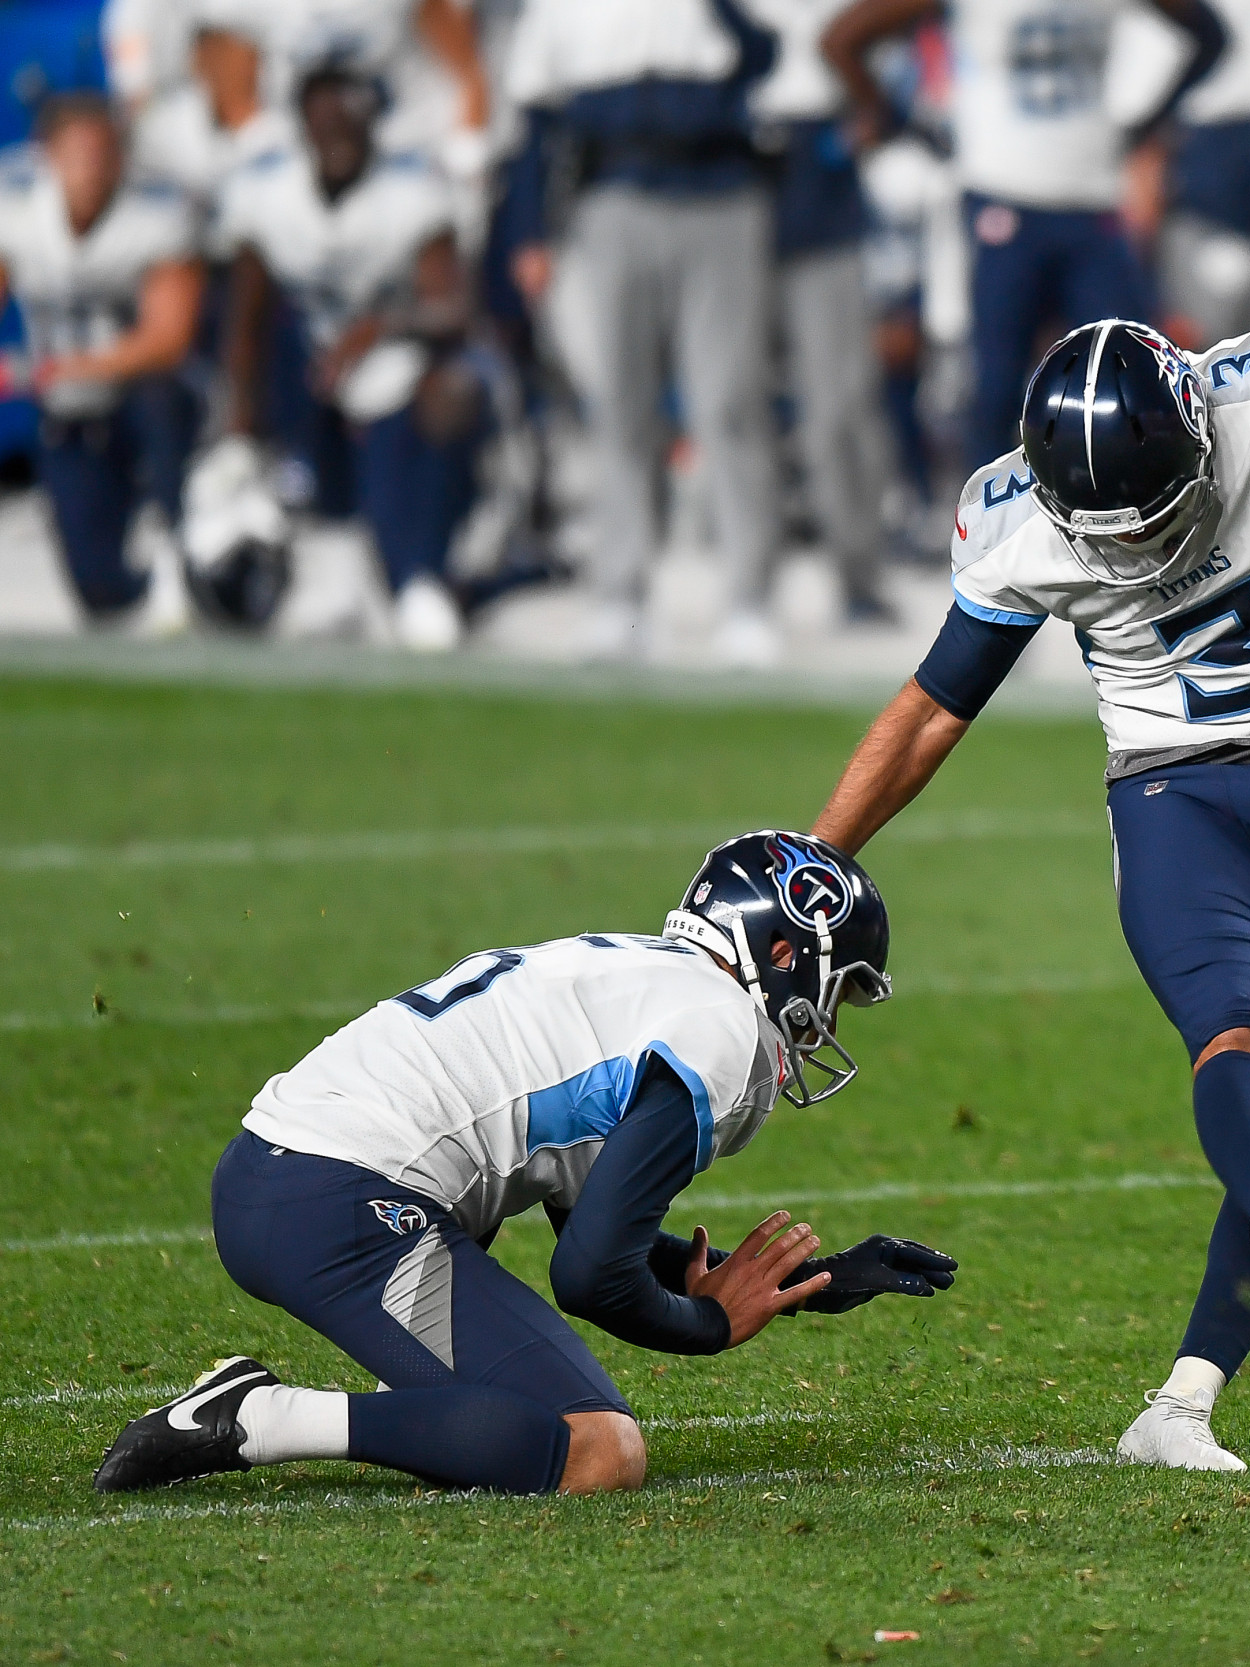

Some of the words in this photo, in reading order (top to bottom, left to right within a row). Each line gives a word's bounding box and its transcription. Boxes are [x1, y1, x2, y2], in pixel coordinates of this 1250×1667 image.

[1086, 515, 1122, 525] TITANS
[1146, 545, 1232, 604] TITANS
[665, 920, 705, 936] ESSEE
